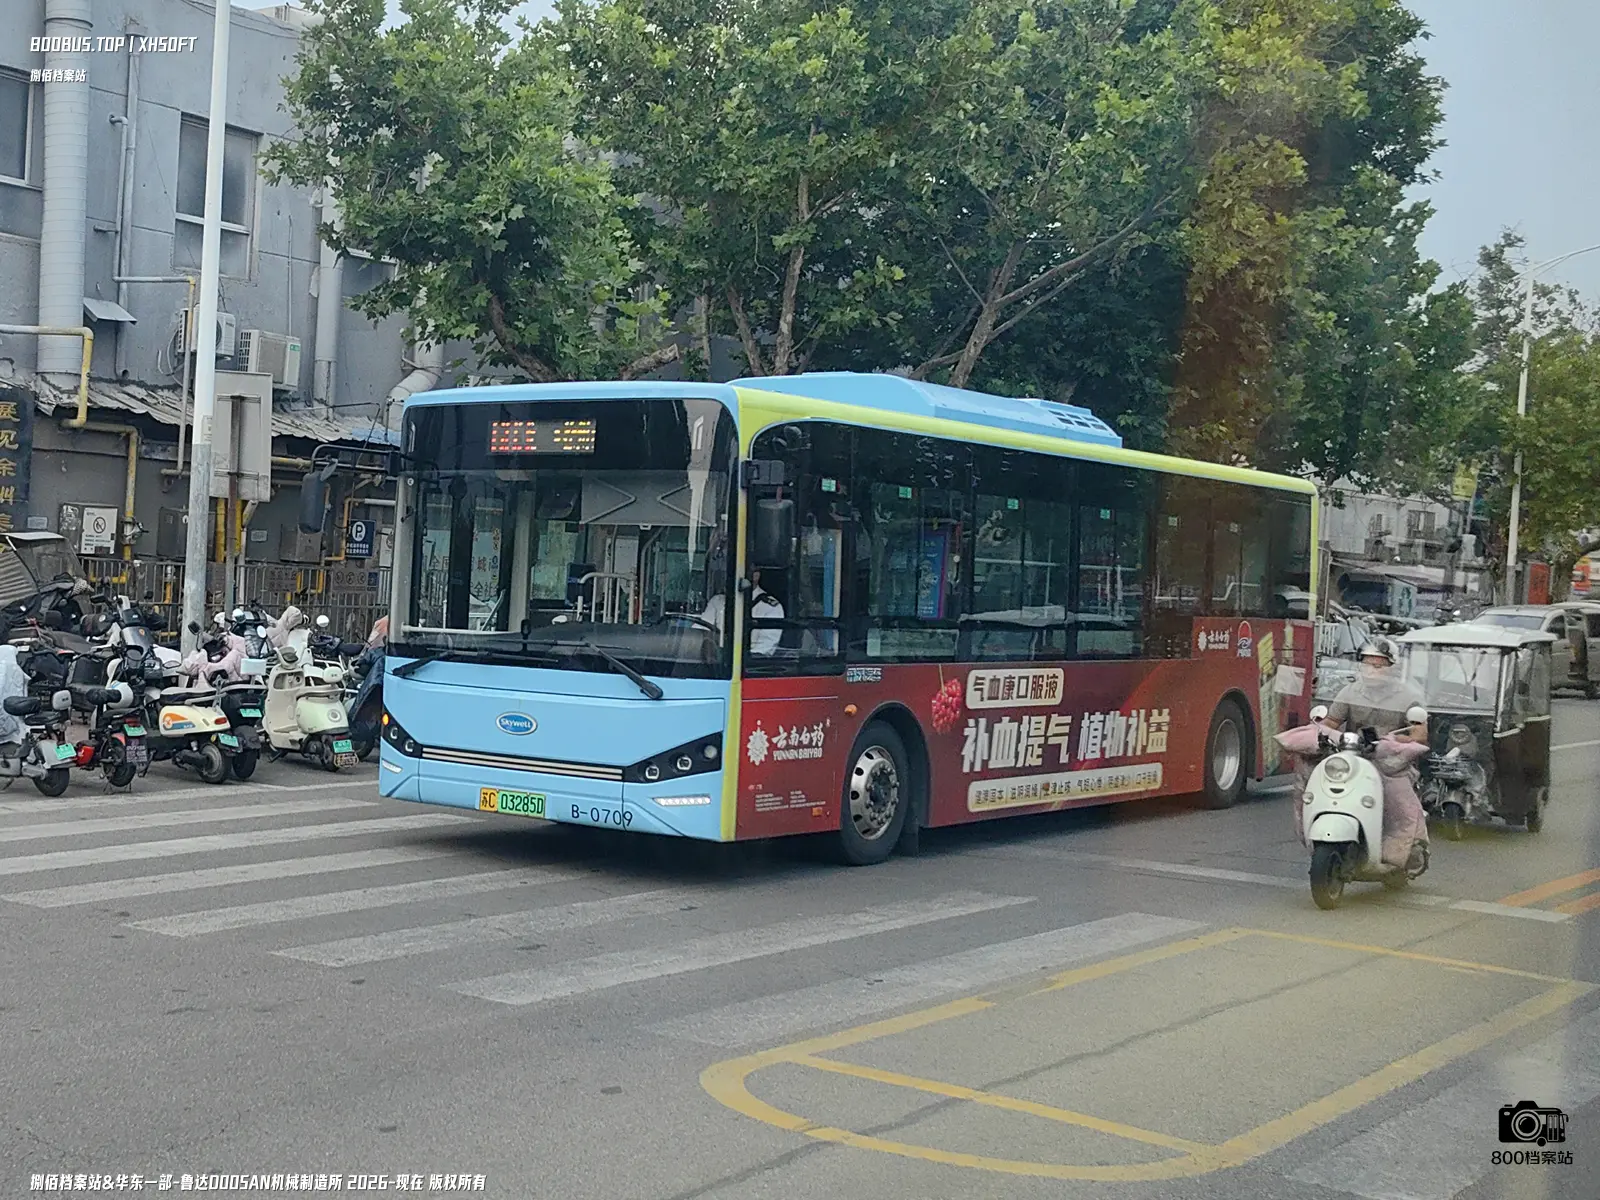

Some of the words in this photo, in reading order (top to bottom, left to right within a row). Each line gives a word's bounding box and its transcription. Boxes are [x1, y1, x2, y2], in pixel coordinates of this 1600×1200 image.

[972, 675, 1059, 702] 气血康口服液
[500, 718, 531, 729] Skywell
[771, 722, 825, 748] 云南白药
[961, 713, 1072, 773] 补血提气
[1077, 708, 1170, 762] 植物补益
[571, 803, 633, 827] B-0709
